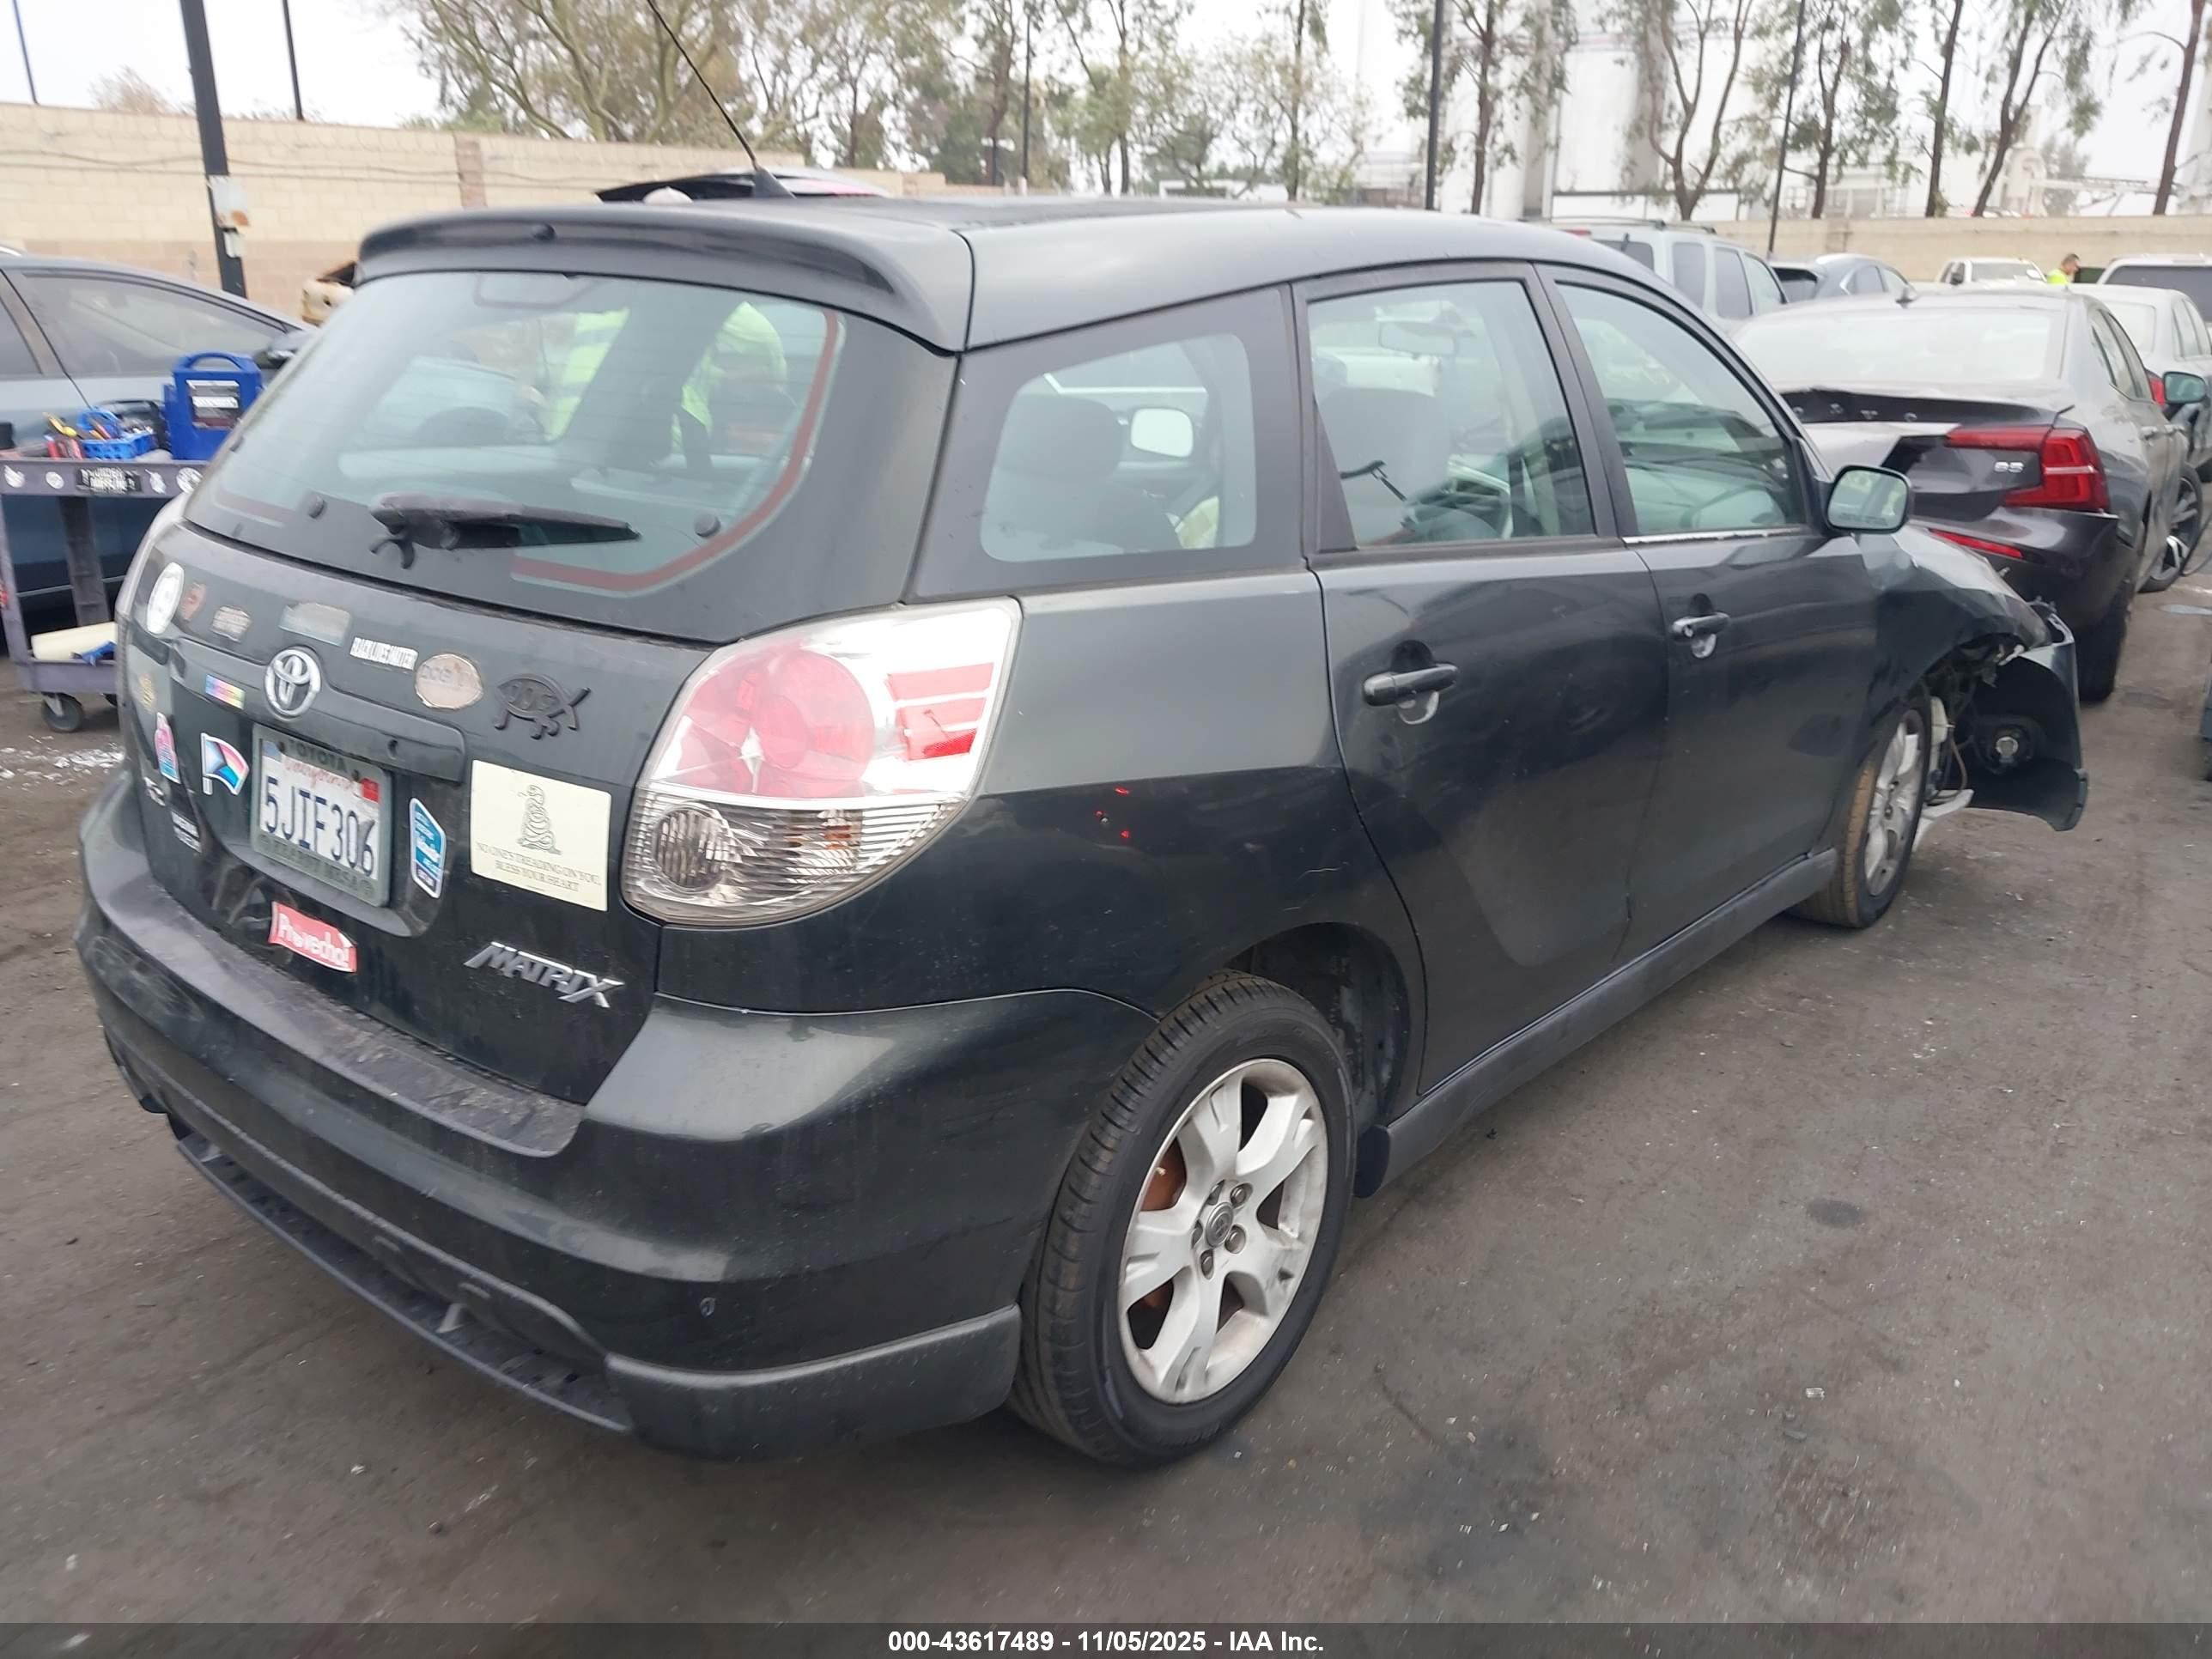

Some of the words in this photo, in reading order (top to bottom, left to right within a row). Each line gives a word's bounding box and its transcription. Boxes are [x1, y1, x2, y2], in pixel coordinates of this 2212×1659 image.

[289, 738, 348, 773] TOYOTA
[265, 775, 375, 877] 5JIF306
[463, 940, 625, 1008] MATRIX
